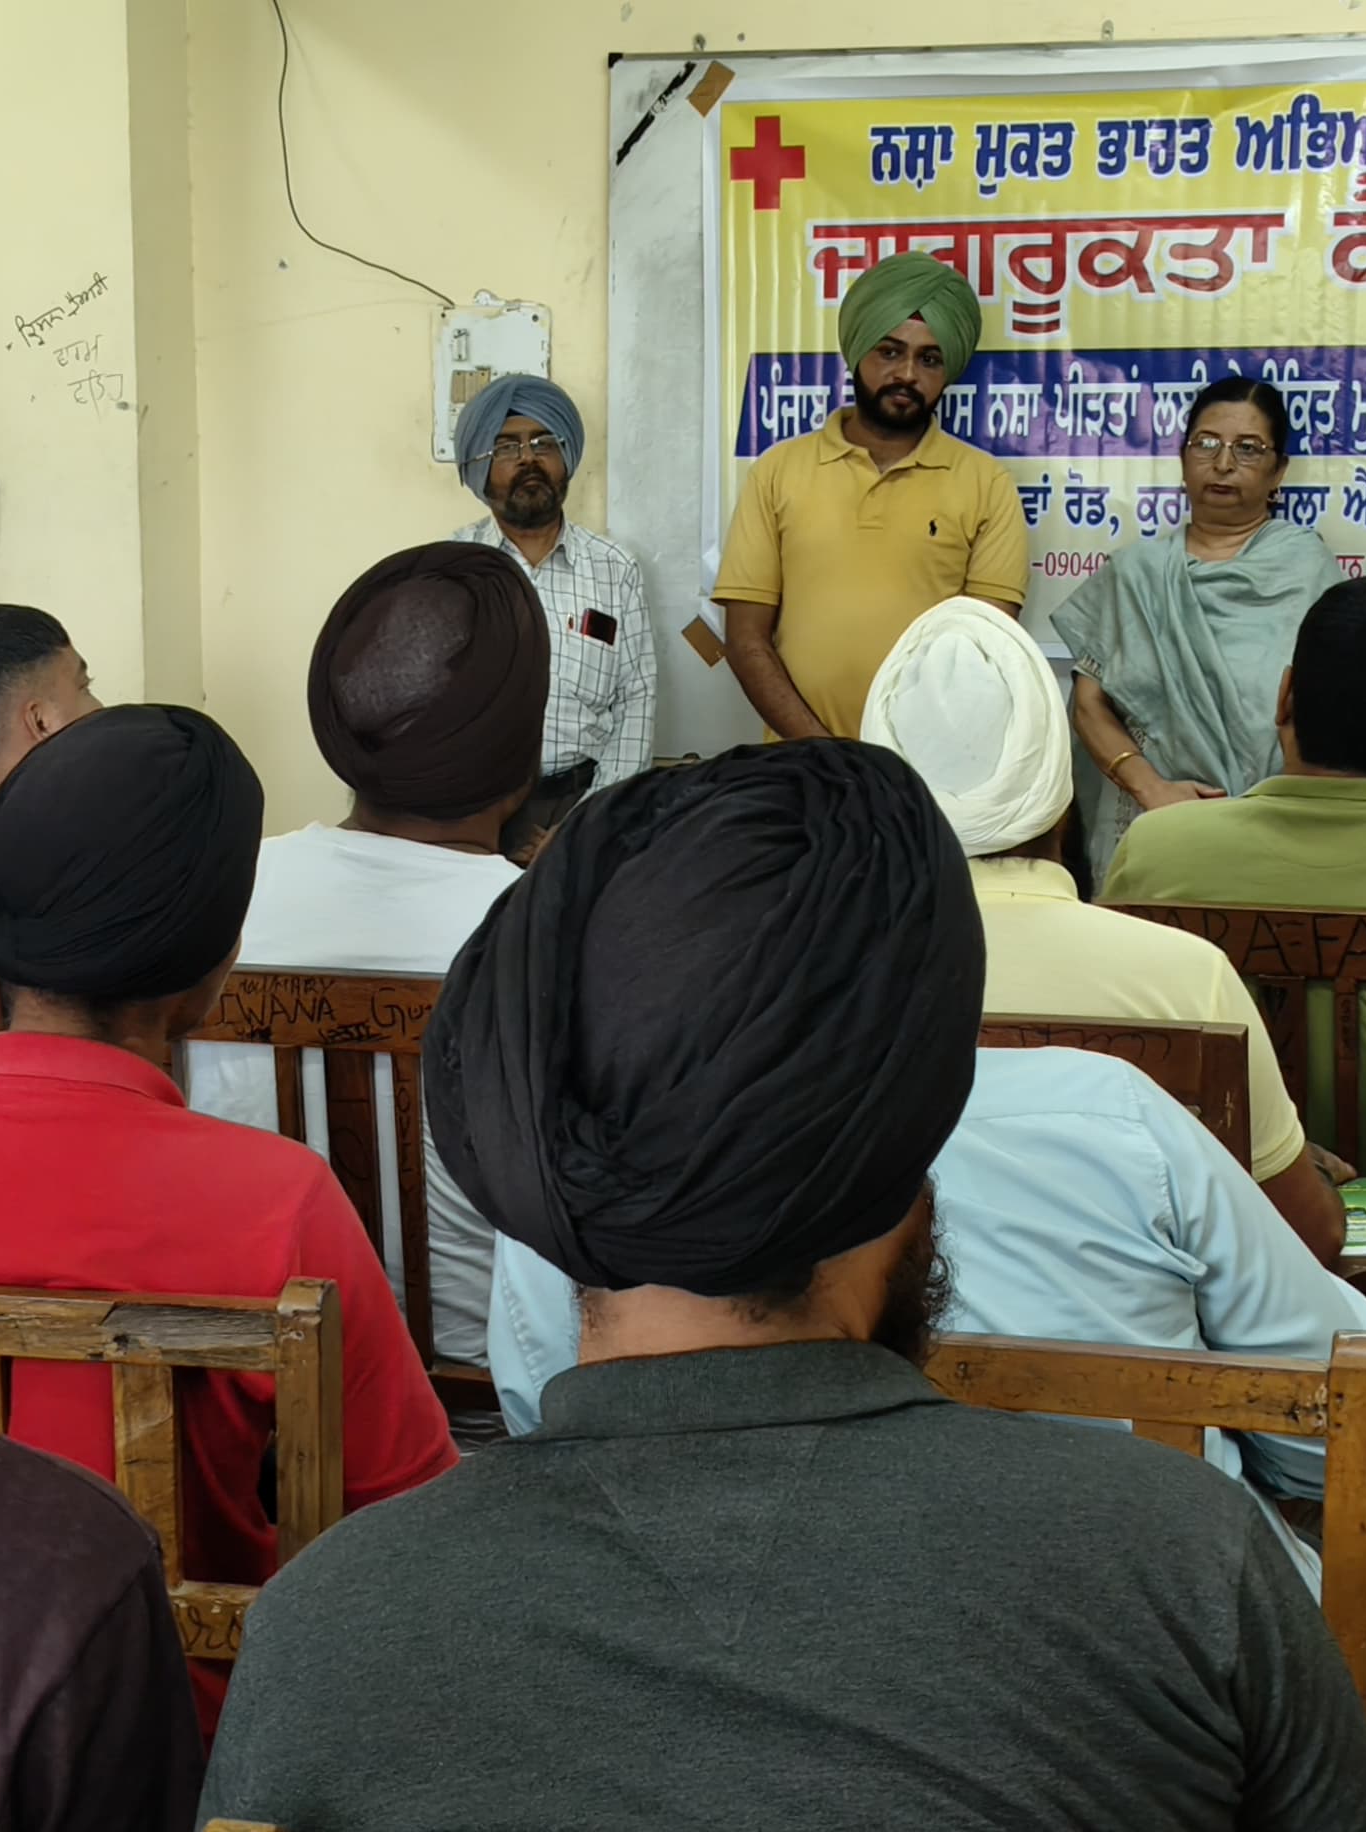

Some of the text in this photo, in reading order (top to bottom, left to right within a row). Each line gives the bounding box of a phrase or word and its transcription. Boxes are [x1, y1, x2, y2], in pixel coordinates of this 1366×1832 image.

[870, 124, 954, 190] ਨਸ਼ਾ
[975, 121, 1076, 195] ਮੁਕਤ
[1096, 117, 1212, 176] ਭਾਰਤ
[759, 360, 831, 439] ਪੰਜਾਬ
[987, 383, 1043, 438] ਨਸ਼ਾ
[1053, 360, 1142, 437] ਪੀੜਤਾਂ
[1136, 485, 1189, 537] ਕੁਰਾ
